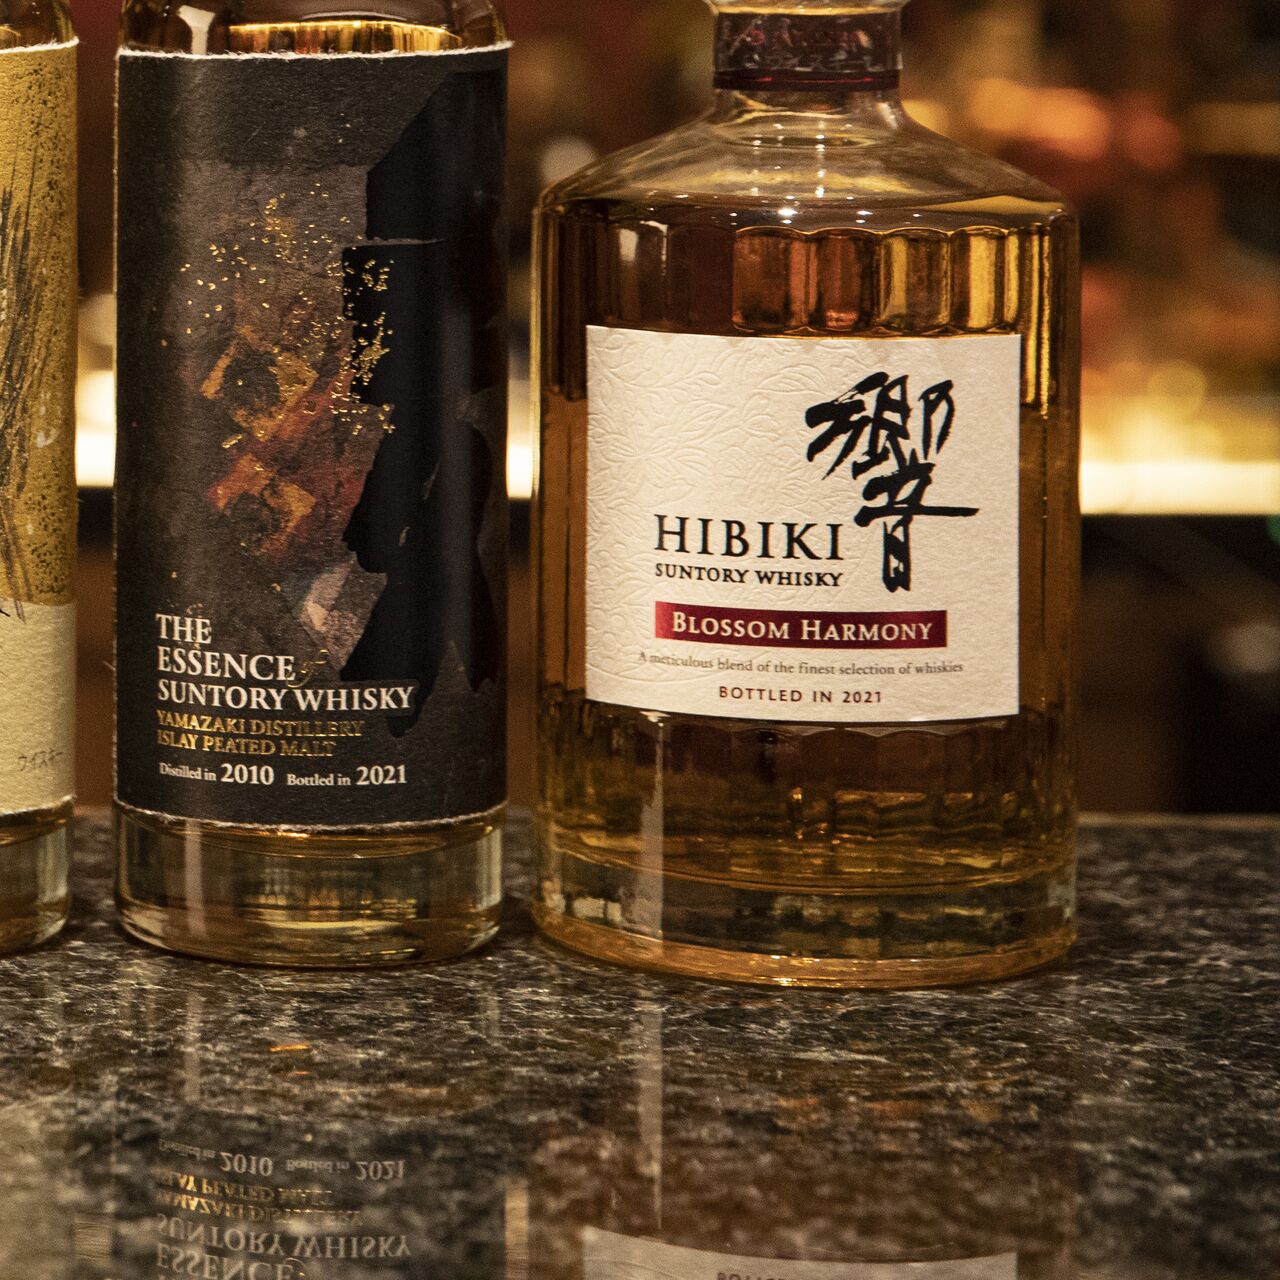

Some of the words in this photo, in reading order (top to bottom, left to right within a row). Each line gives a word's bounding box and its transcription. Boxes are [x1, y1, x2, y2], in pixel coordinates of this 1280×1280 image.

[804, 371, 979, 593] 響
[654, 514, 844, 560] HIBIKI
[655, 563, 749, 584] SUNTORY
[755, 570, 844, 587] WHISKY
[156, 613, 212, 644] THE
[157, 646, 296, 681] ESSENCE
[649, 653, 714, 669] meticulous
[717, 658, 753, 672] blend
[757, 661, 770, 673] of
[775, 663, 795, 674] the
[799, 662, 835, 675] finest
[840, 663, 896, 675] selection
[899, 662, 913, 675] of
[915, 661, 963, 674] whiskies
[158, 679, 288, 711] SUNTORY
[294, 686, 414, 712] WHISKY
[719, 686, 803, 702] BOTTLED
[813, 690, 832, 703] IN
[842, 691, 882, 704] 2021
[156, 710, 245, 734] YAMAZAKI
[251, 719, 364, 737] DISTILLERY
[157, 730, 198, 751] ISLAY
[203, 734, 276, 756] PEATED
[280, 740, 336, 757] MALT
[159, 762, 201, 780] Distilled
[204, 768, 216, 781] in
[220, 763, 274, 785] 2010
[287, 774, 333, 786] Bottled
[337, 774, 351, 786] in
[356, 765, 407, 786] 2021
